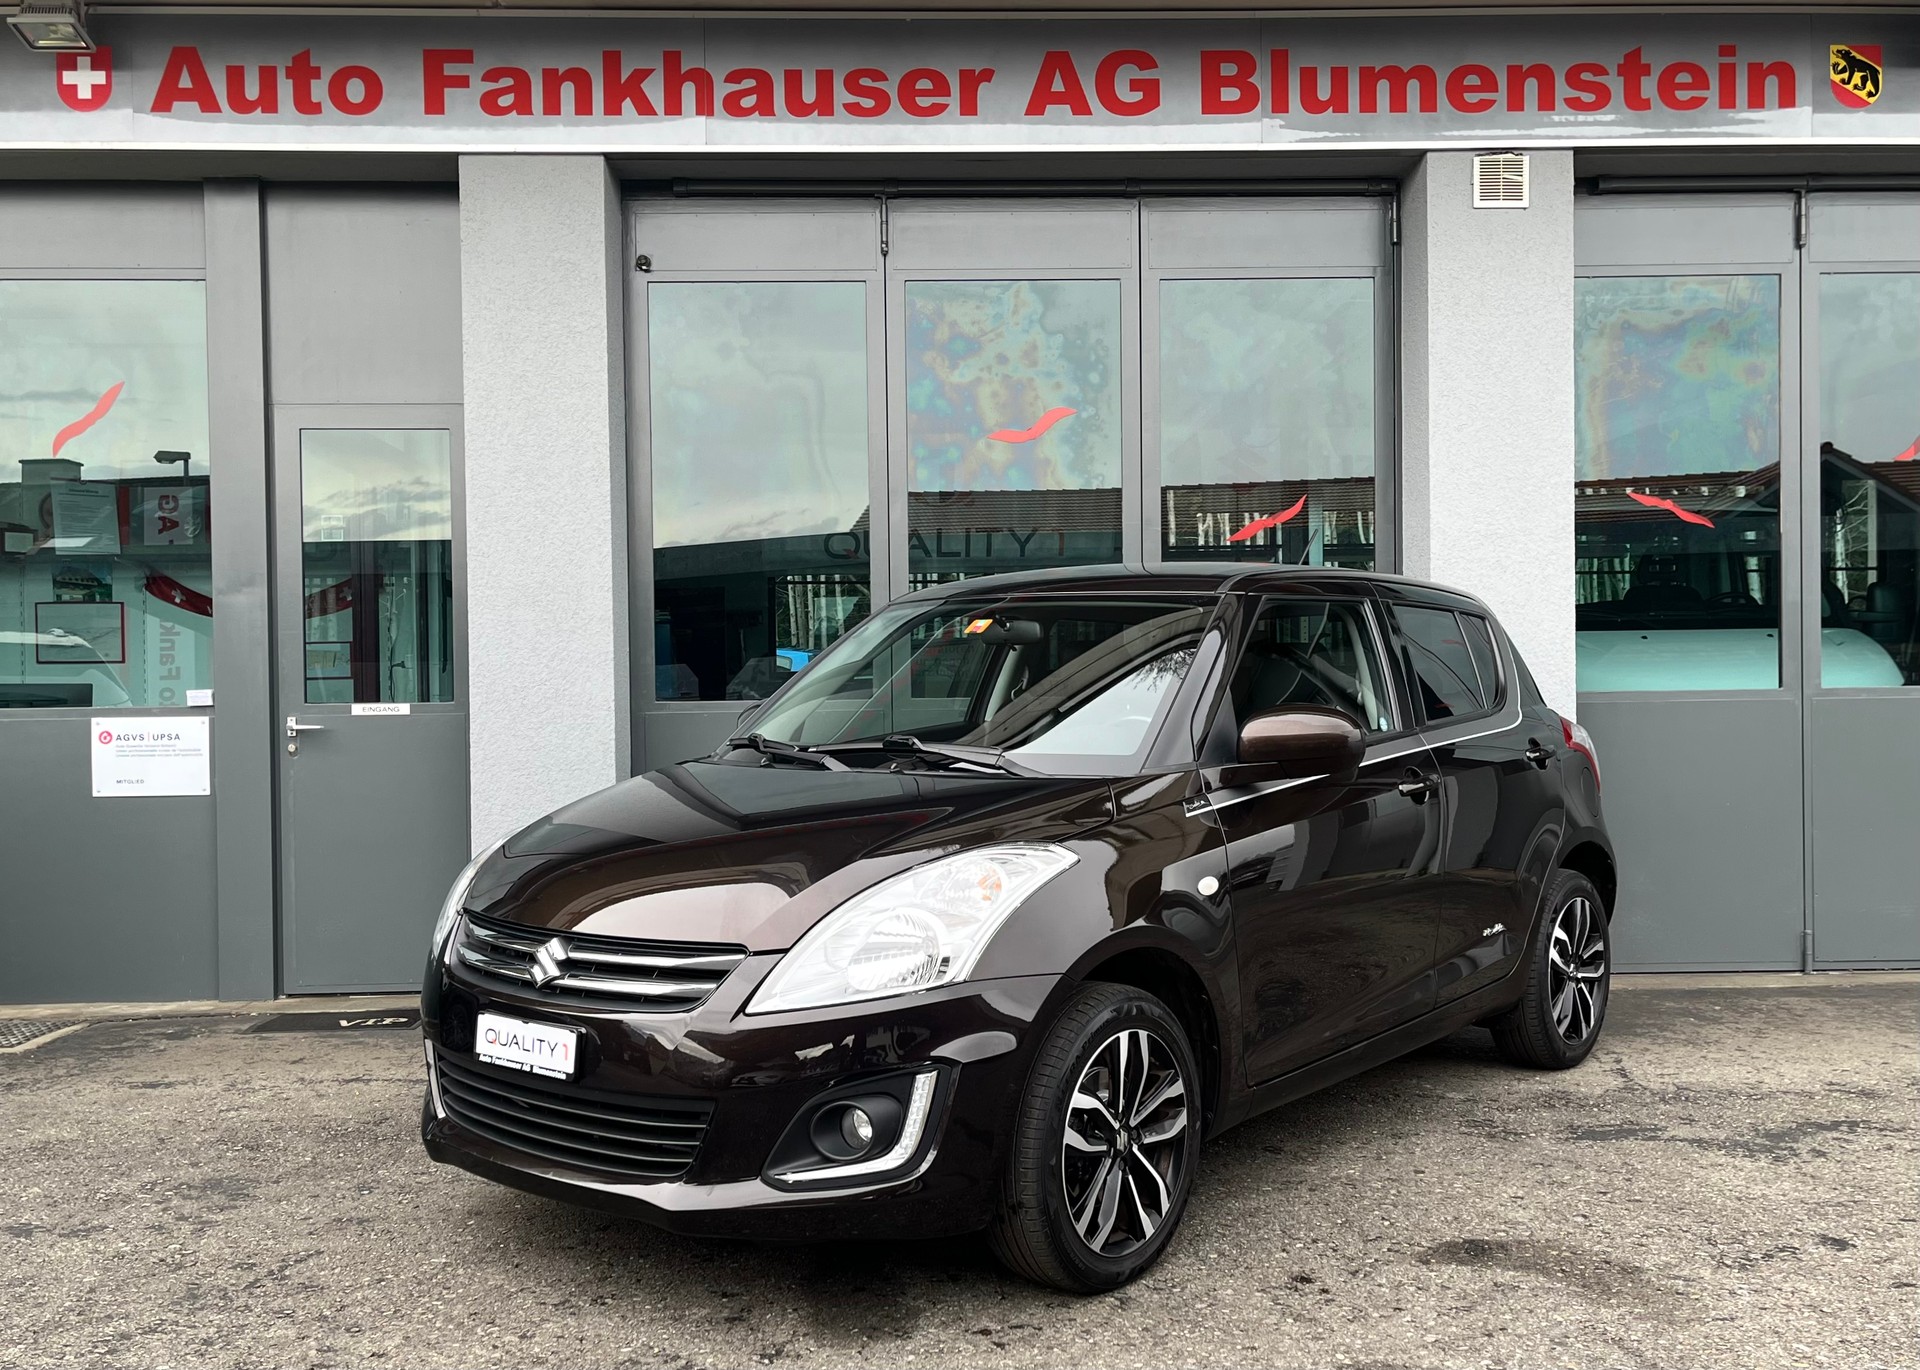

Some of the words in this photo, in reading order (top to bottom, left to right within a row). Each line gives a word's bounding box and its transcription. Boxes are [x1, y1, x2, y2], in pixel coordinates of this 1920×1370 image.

[151, 46, 384, 116] Auto
[422, 50, 995, 118] Fankhauser
[1025, 50, 1161, 117] AG
[1201, 46, 1797, 116] Blumenstein
[115, 733, 145, 741] AGVS
[152, 733, 181, 741] UPSA
[339, 1017, 408, 1027] VIP
[485, 1028, 558, 1058] QUALITY
[562, 1043, 569, 1061] 1
